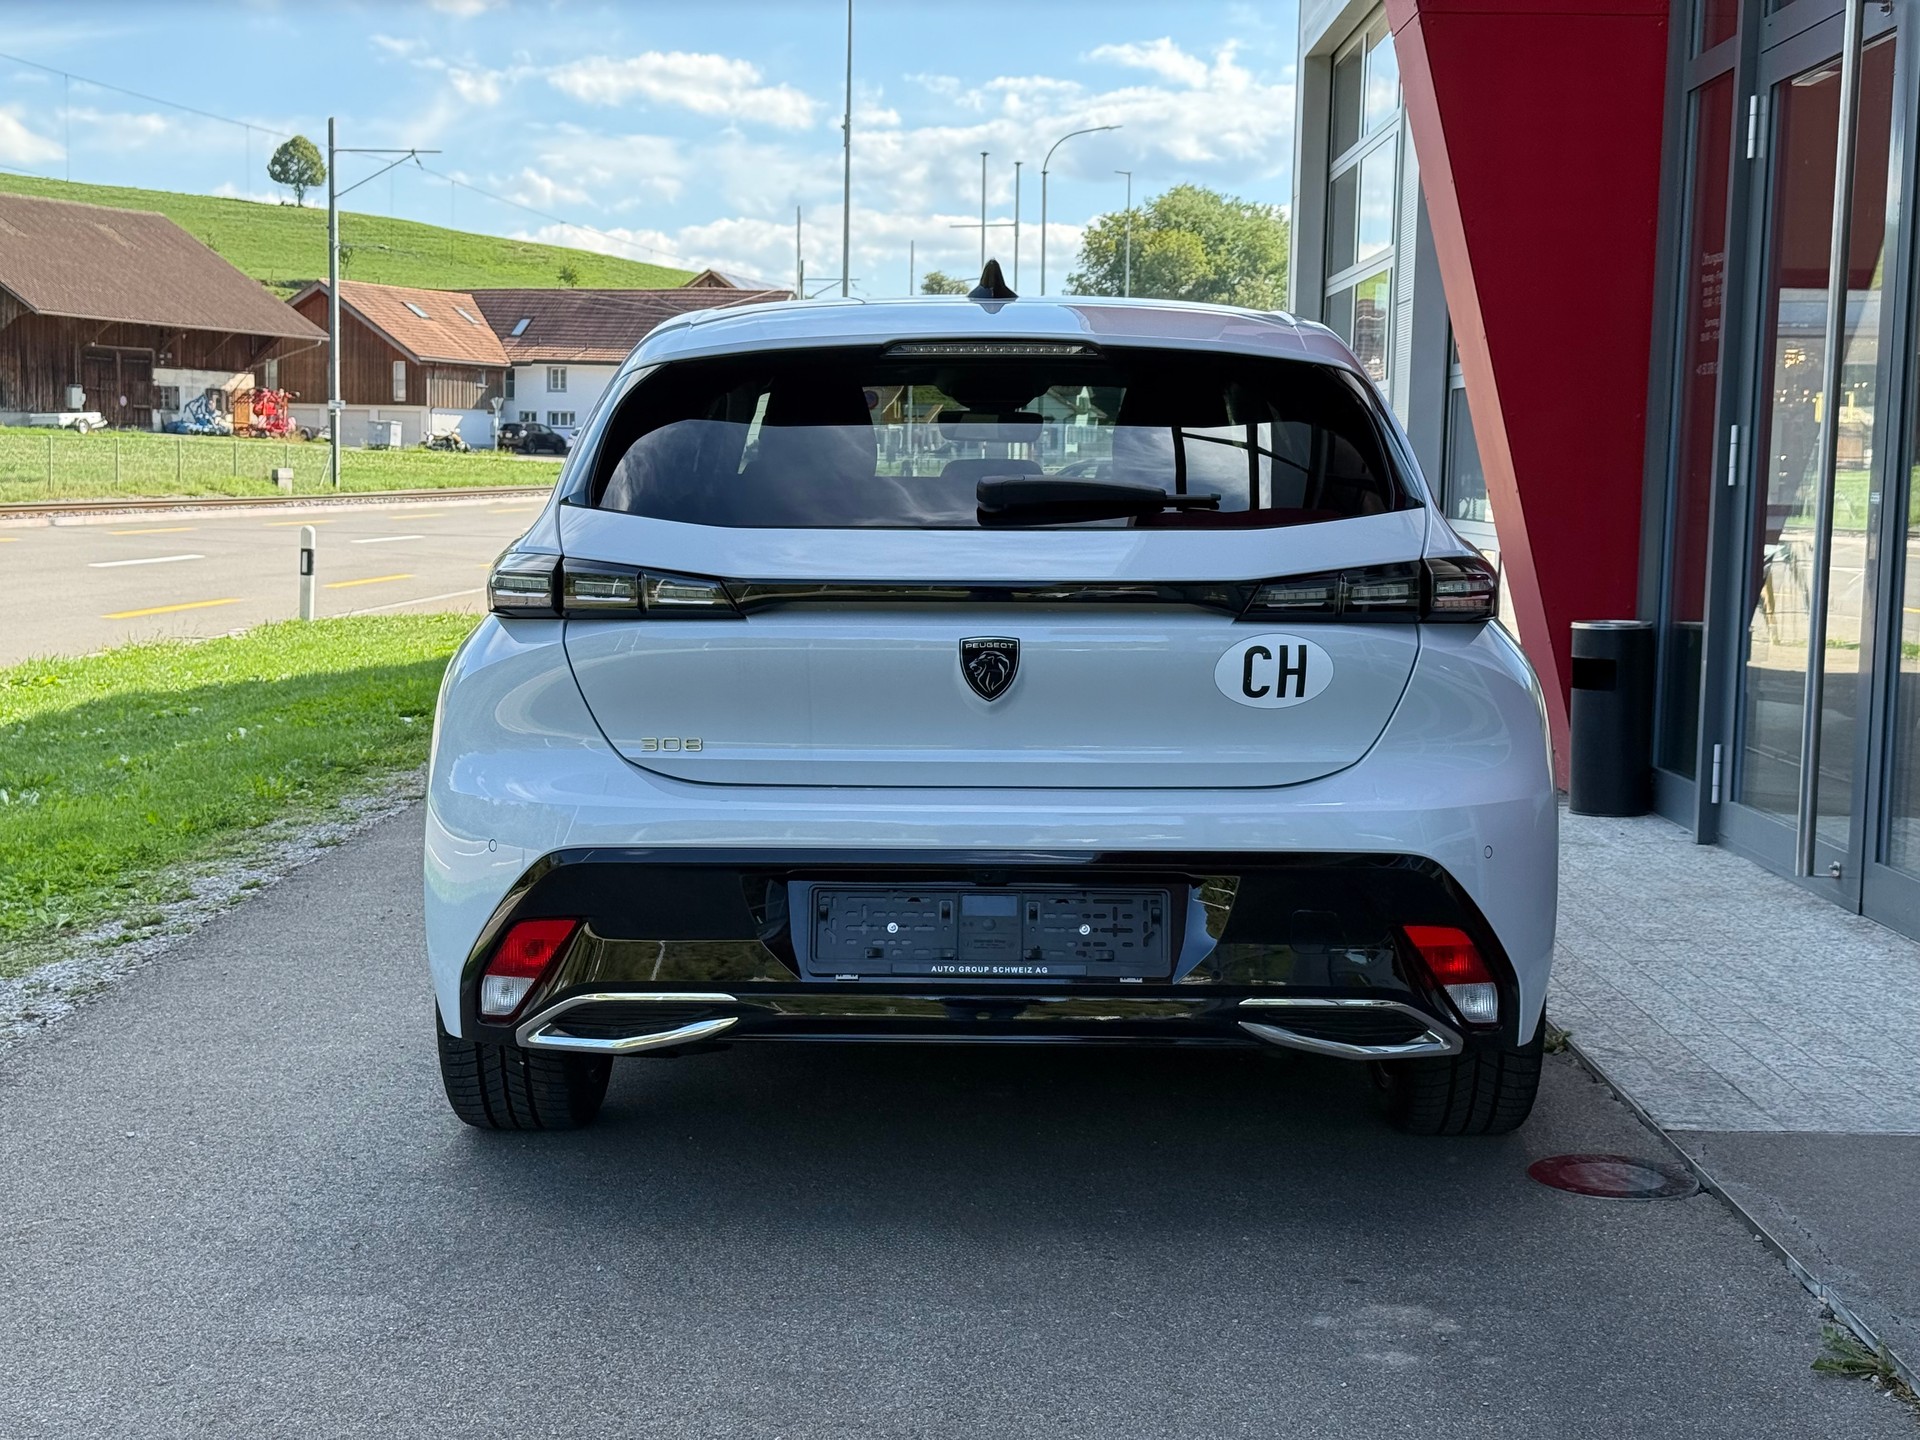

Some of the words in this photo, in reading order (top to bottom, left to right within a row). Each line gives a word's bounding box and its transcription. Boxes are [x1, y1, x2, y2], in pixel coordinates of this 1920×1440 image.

[1242, 644, 1307, 699] CH
[641, 737, 703, 752] 308
[931, 965, 956, 973] AUTO
[958, 965, 990, 973] GROUP
[992, 966, 1033, 974] SCHWEIZ
[1035, 966, 1048, 974] AG
